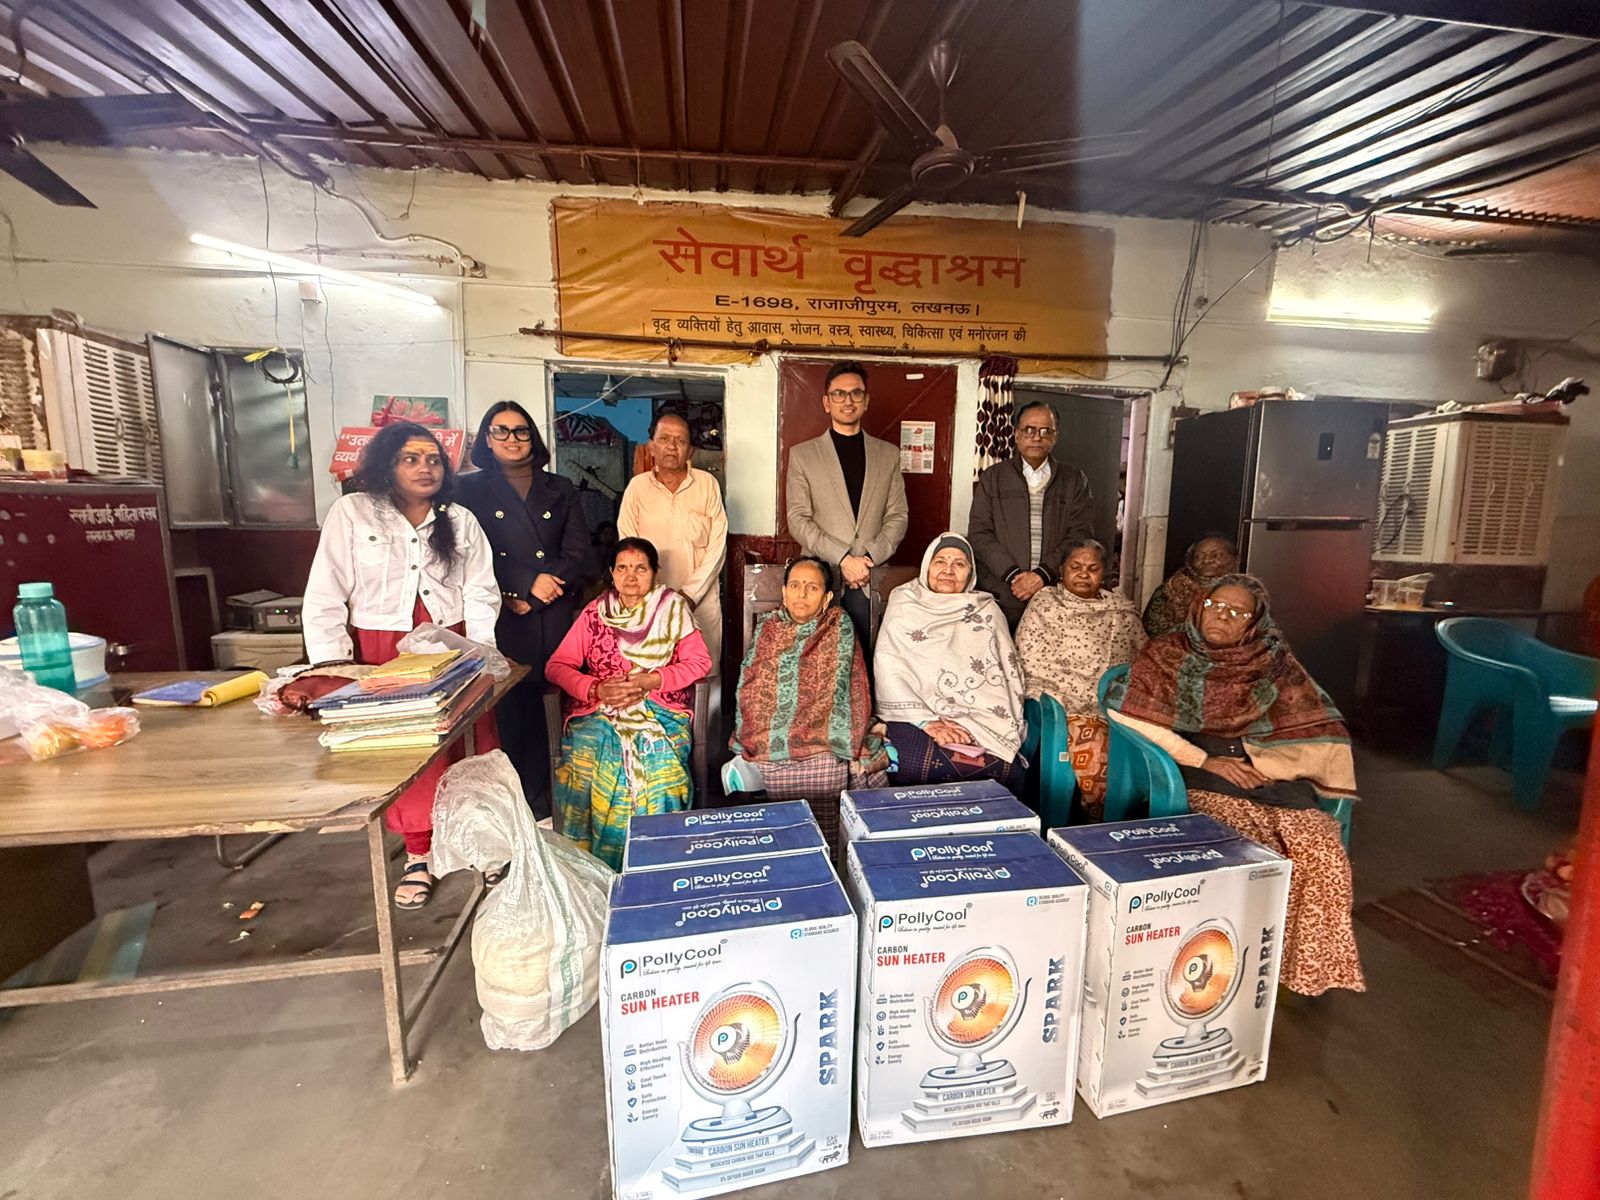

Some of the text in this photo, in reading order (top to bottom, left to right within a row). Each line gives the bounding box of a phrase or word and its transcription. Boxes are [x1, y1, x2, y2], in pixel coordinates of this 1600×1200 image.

[652, 227, 1027, 294] सेवार्थ वृद्धाश्रम
[715, 295, 799, 311] E-1698,
[807, 296, 901, 315] राजाजीपुरम,
[652, 316, 1026, 341] वृद्ध व्यक्तियों हेतु आवास, भोजन, वस्त्र, स्वास्थ्य, चिकित्सा एवं मनोरंजन की
[908, 786, 962, 798] PollyCool
[702, 809, 765, 824] PollyCool
[690, 835, 757, 851] PollyCool
[928, 842, 994, 859] PollyCool
[694, 869, 768, 886] PollyCool
[922, 868, 995, 885] PollyCool
[1145, 885, 1200, 905] PollyCool
[681, 898, 763, 922] PollyCool
[899, 908, 967, 926] PollyCool
[1125, 926, 1181, 945] SUN HEATER
[1126, 923, 1151, 934] CARBON
[643, 943, 722, 967] PollyCool
[877, 945, 908, 954] CARBON
[877, 952, 945, 966] SUN HEATER
[1254, 924, 1275, 1010] SPARK
[621, 988, 657, 1003] CARBON
[621, 991, 699, 1015] SUN HEATER
[1042, 955, 1065, 1044] SPARK
[819, 988, 838, 1086] SPARK
[708, 1136, 770, 1156] CARBON SUN HEATER
